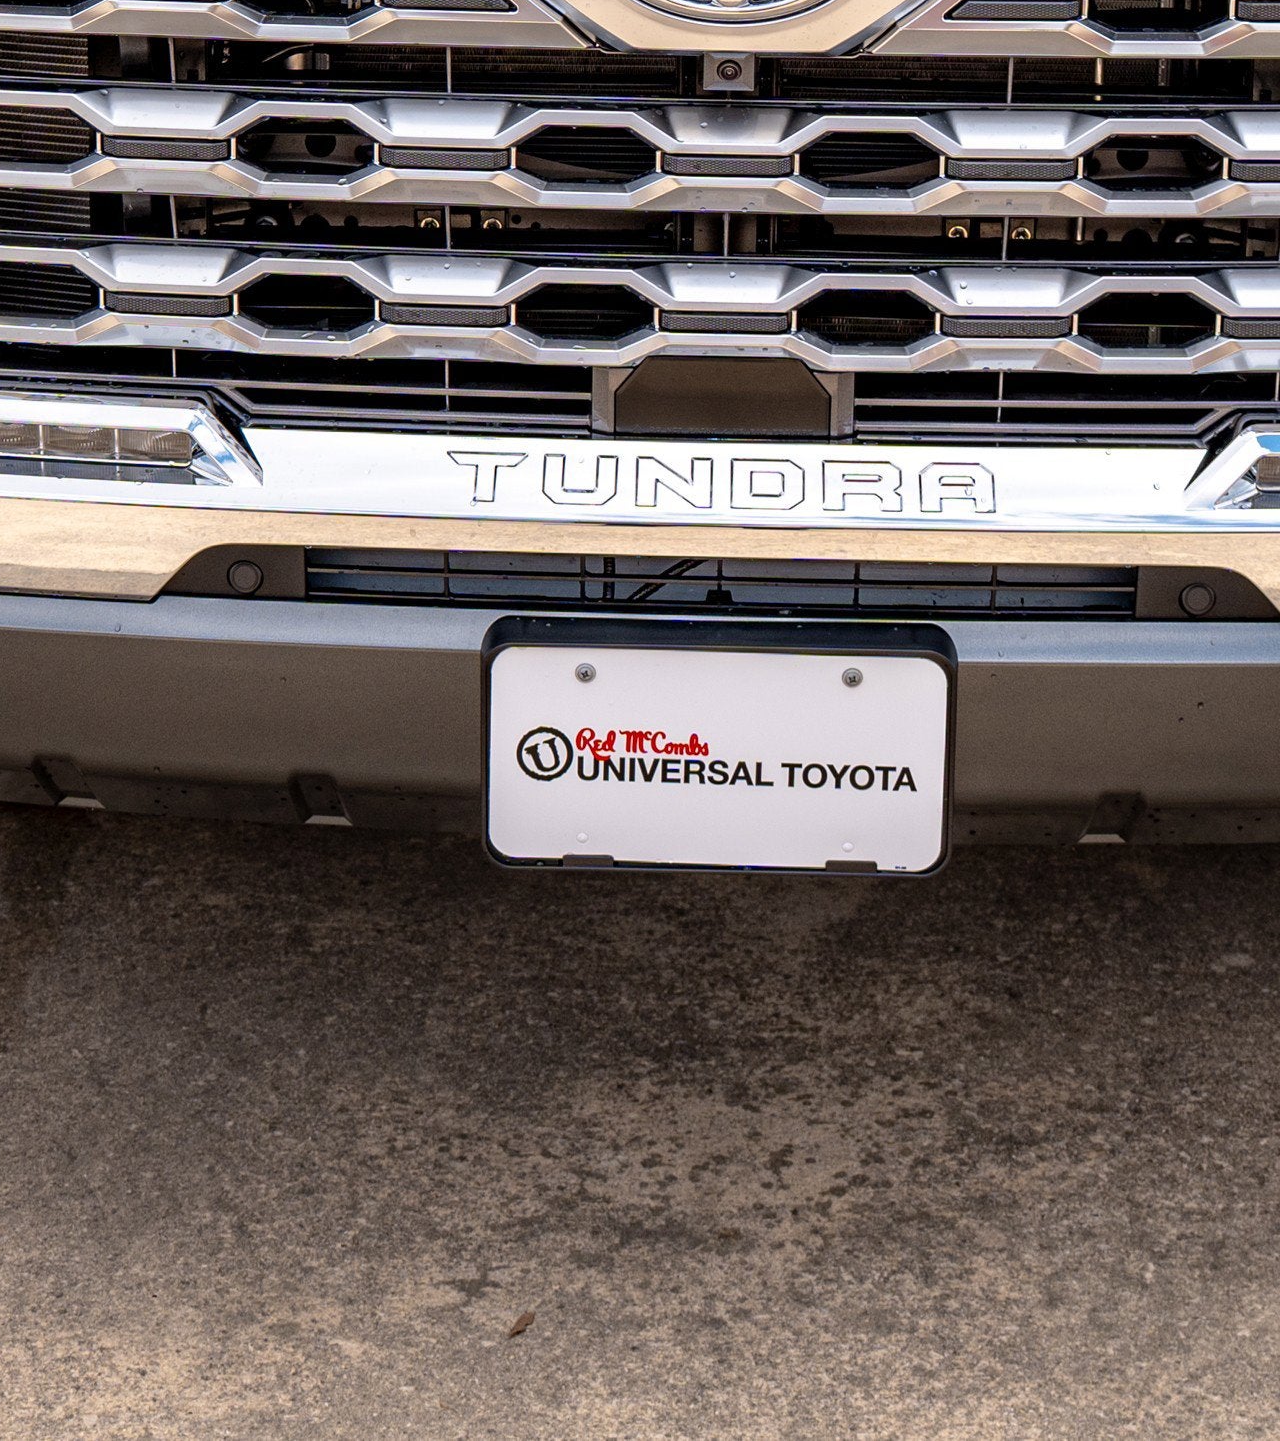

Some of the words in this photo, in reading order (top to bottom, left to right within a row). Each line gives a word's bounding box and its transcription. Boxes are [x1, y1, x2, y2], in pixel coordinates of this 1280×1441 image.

[447, 451, 997, 513] TUNDRA
[575, 727, 616, 761] Red
[577, 756, 775, 787] UNIVERSAL
[781, 762, 918, 793] TOYOTA
